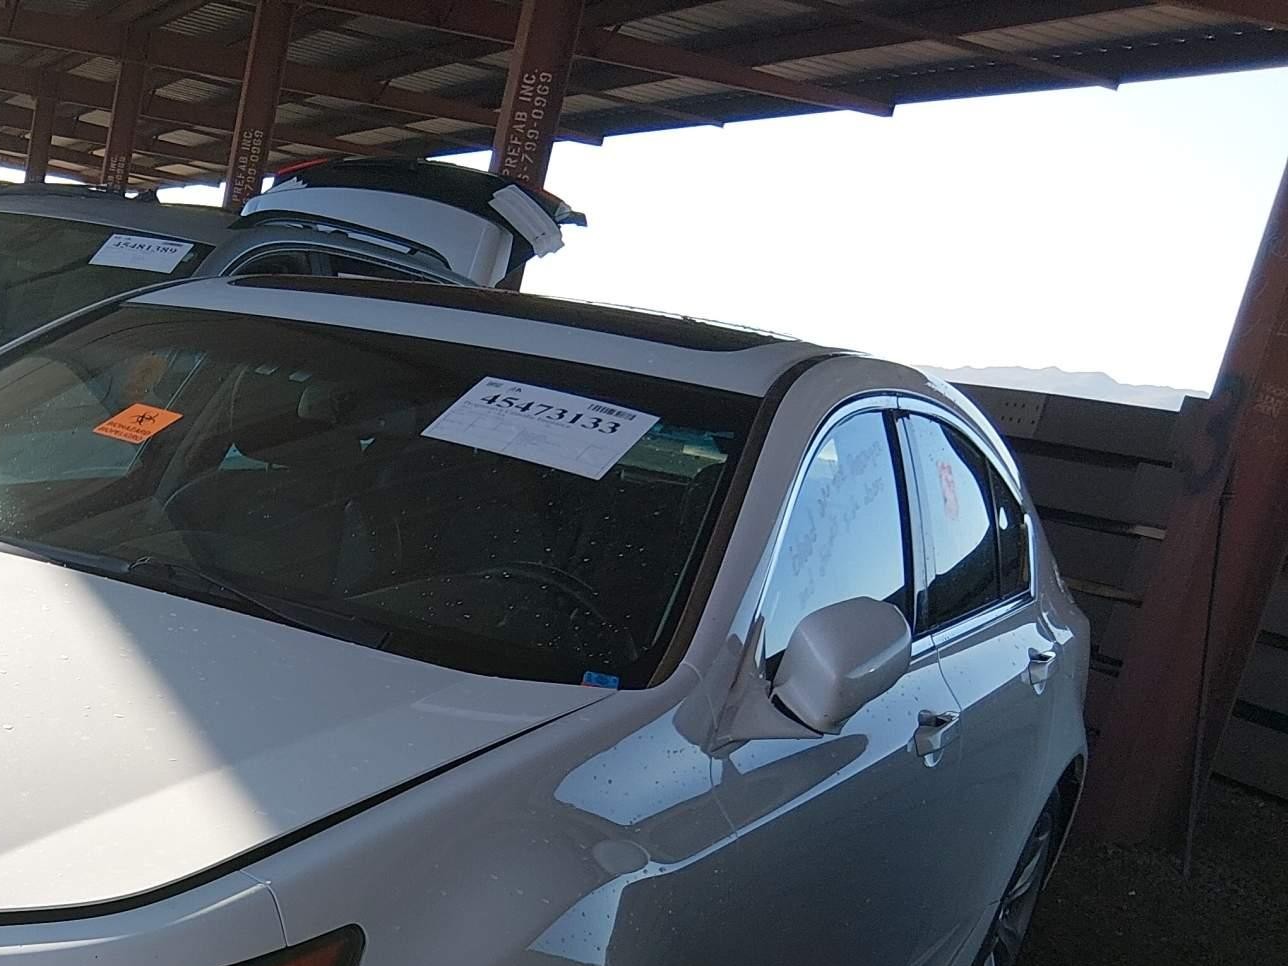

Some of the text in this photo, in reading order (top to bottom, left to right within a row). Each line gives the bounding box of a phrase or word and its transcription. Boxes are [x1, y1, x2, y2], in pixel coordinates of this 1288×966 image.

[502, 68, 539, 176] PREFAB INC.
[232, 156, 249, 203] PREFAB
[479, 393, 622, 435] 45473133
